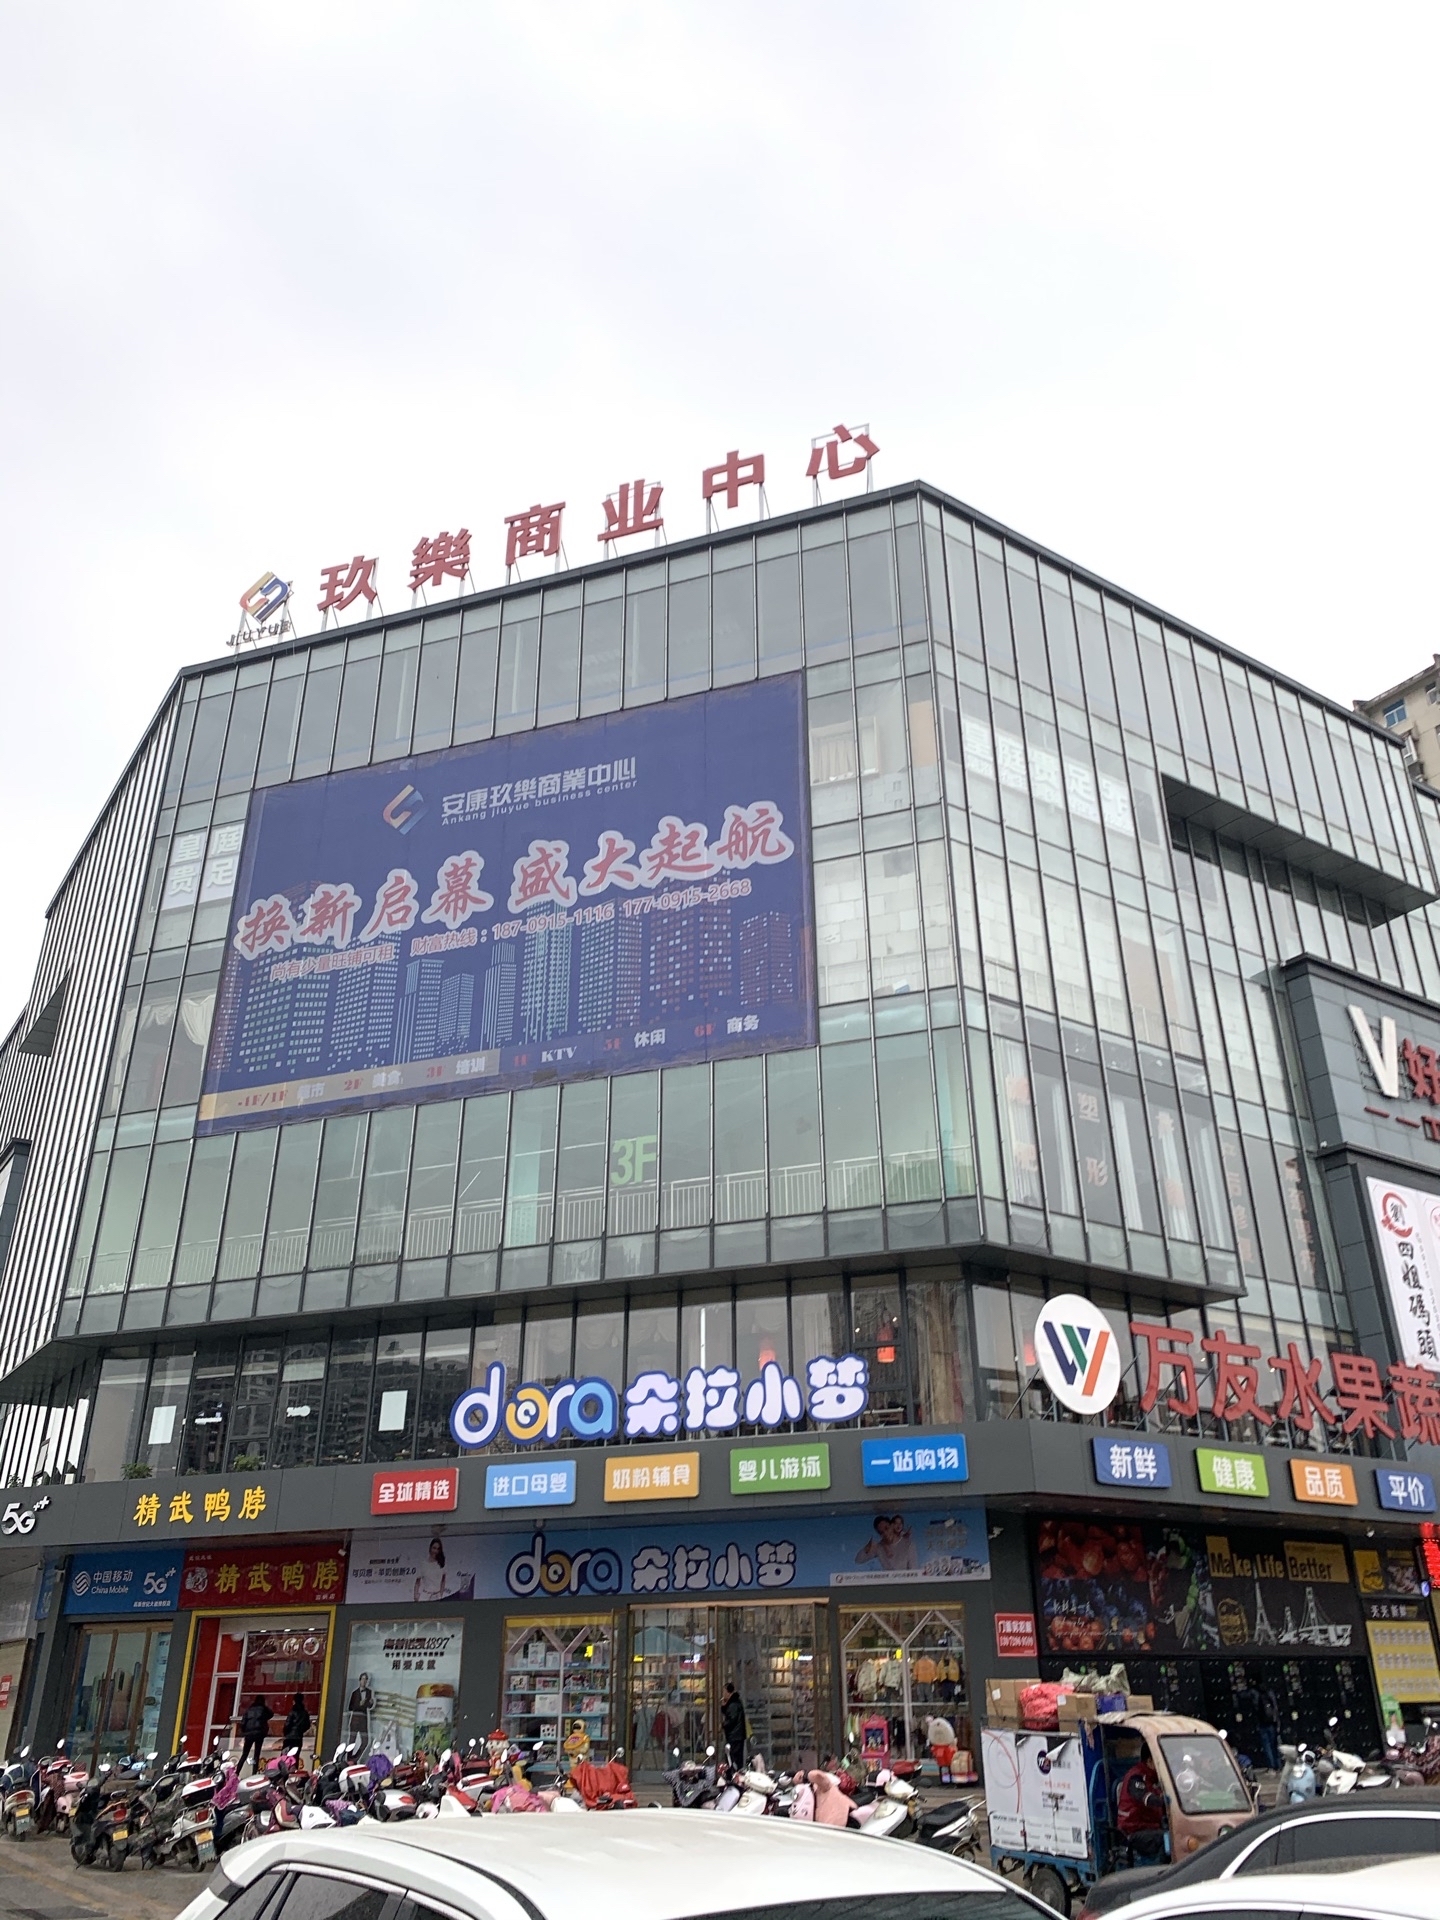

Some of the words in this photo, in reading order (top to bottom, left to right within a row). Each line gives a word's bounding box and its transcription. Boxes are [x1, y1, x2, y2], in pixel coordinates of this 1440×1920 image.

[318, 424, 880, 612] 玖樂商业中心
[441, 756, 636, 818] 安康玖樂商業中心
[442, 811, 487, 826] Ankang
[535, 789, 591, 807] business
[597, 780, 638, 795] center
[237, 853, 491, 957] 换新启幕
[511, 804, 791, 908] 盛大起航
[270, 944, 394, 981] 尚有少量旺铺可租
[492, 906, 615, 940] 187-0915-1116
[623, 878, 752, 918] 177-0915-2668
[455, 1056, 487, 1075] 培训
[540, 1045, 578, 1063] KTV
[633, 1028, 666, 1048] 休闲
[726, 1014, 760, 1035] 商务
[610, 1134, 657, 1185] 3F
[451, 1362, 616, 1448] dora
[624, 1353, 869, 1439] 朵拉小梦
[1130, 1322, 1440, 1447] 万友水果蔬
[612, 1463, 691, 1489] 奶粉辅食
[738, 1455, 821, 1482] 婴儿游泳
[870, 1447, 959, 1473] 一站购物
[1110, 1444, 1158, 1482] 新鲜
[1212, 1454, 1257, 1491] 健康
[378, 1478, 450, 1504] 全球精选
[493, 1472, 567, 1497] 进口母婴
[1305, 1467, 1345, 1500] 品质
[1388, 1474, 1426, 1508] 平价
[133, 1485, 267, 1527] 精武鸭脖
[93, 1569, 133, 1584] 中国移动
[215, 1558, 340, 1594] 精武鸭脖
[508, 1533, 621, 1596] dora
[631, 1540, 797, 1594] 朵拉小梦
[1210, 1551, 1253, 1577] Make
[1256, 1553, 1285, 1578] Life
[1289, 1556, 1333, 1580] Better
[91, 1586, 108, 1595] China
[109, 1584, 129, 1594] Mobile
